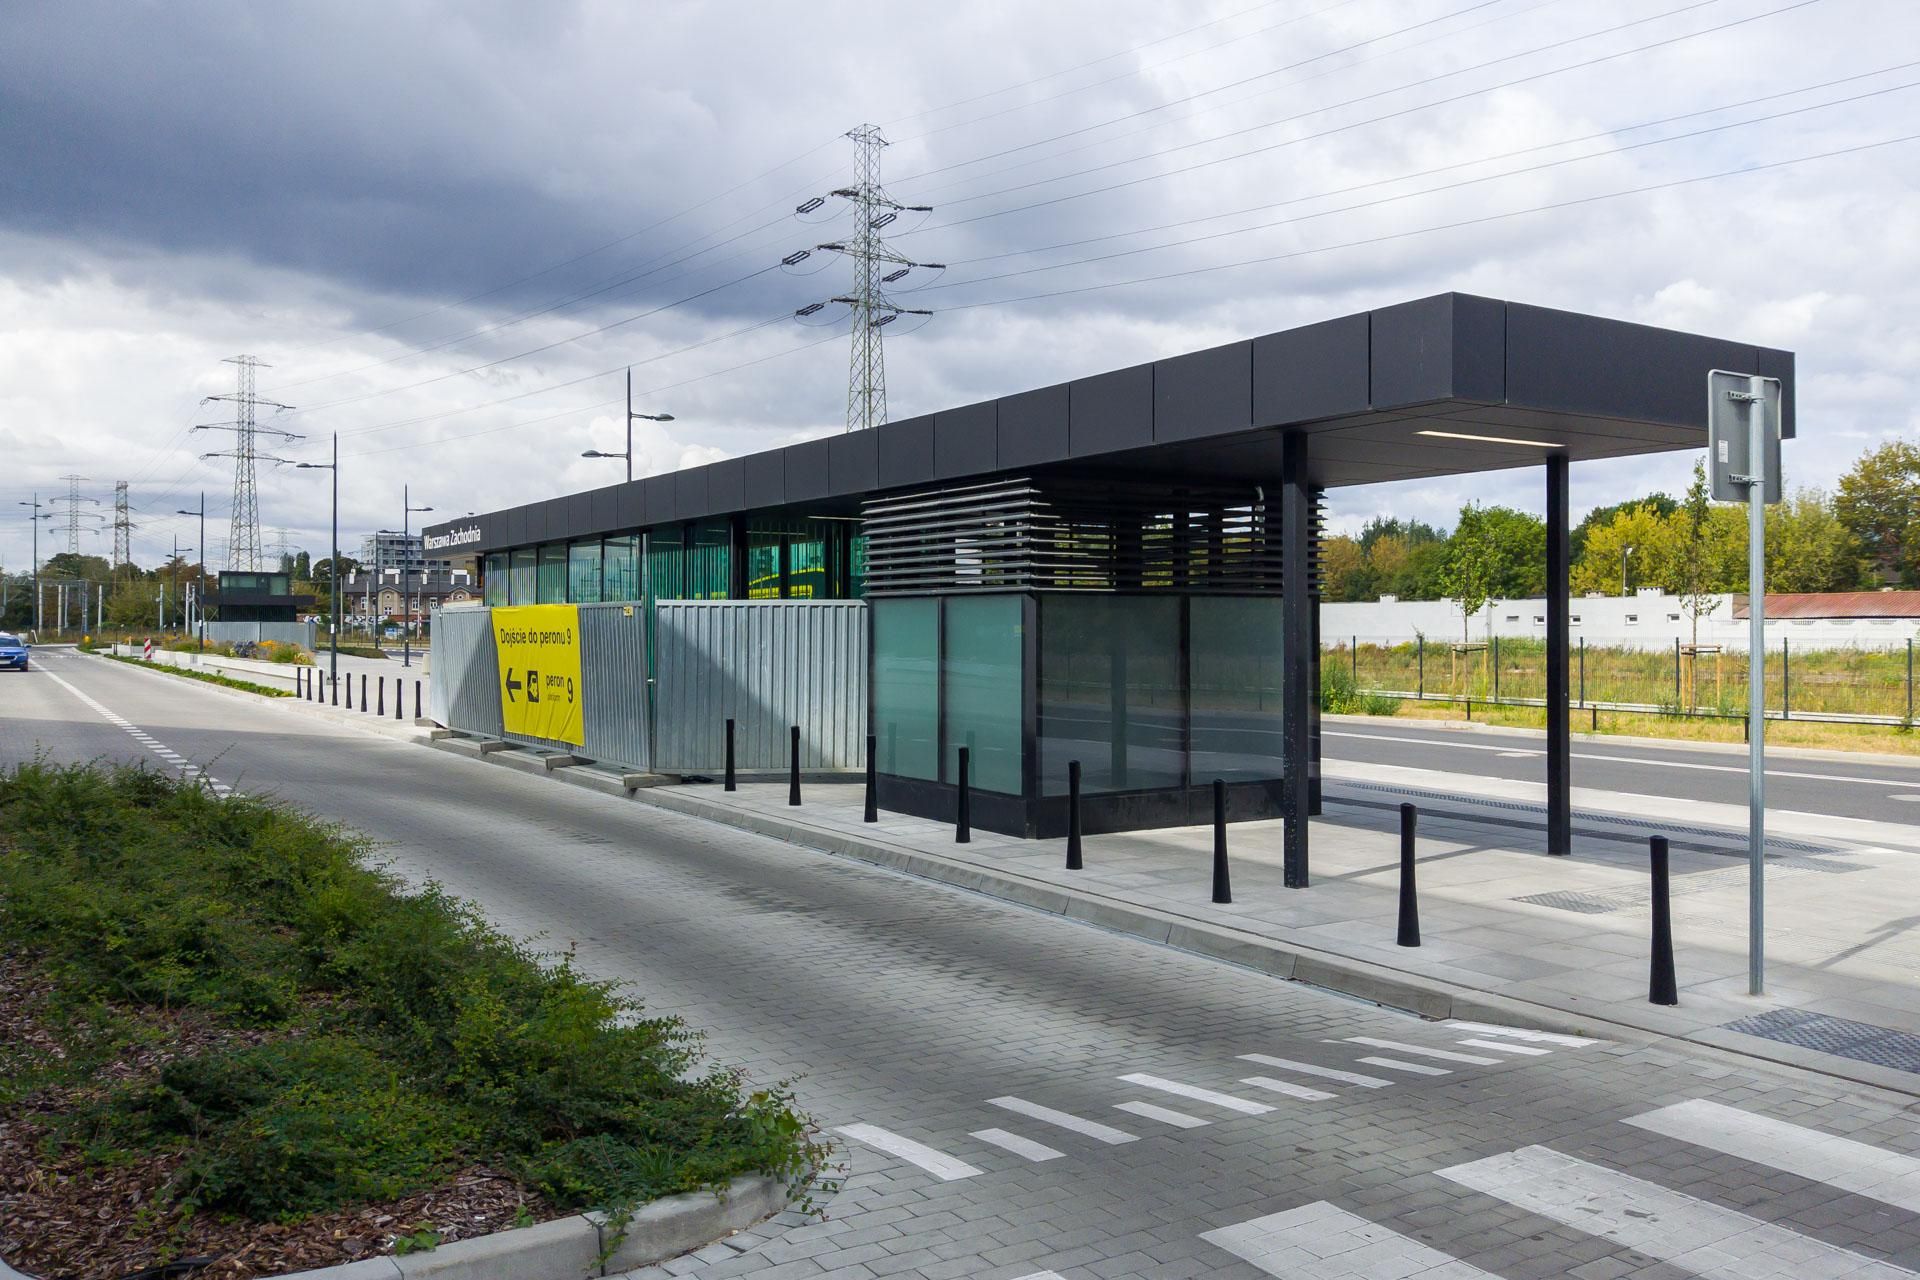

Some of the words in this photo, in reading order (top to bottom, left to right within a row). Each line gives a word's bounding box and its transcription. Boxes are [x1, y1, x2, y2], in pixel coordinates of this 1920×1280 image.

[423, 534, 450, 550] Warszawa
[450, 525, 481, 546] Zachodnia
[500, 627, 527, 648] Dojście
[528, 626, 538, 644] do
[539, 631, 566, 648] peronu
[566, 628, 572, 645] 9
[546, 675, 565, 690] peron
[567, 677, 574, 704] 9
